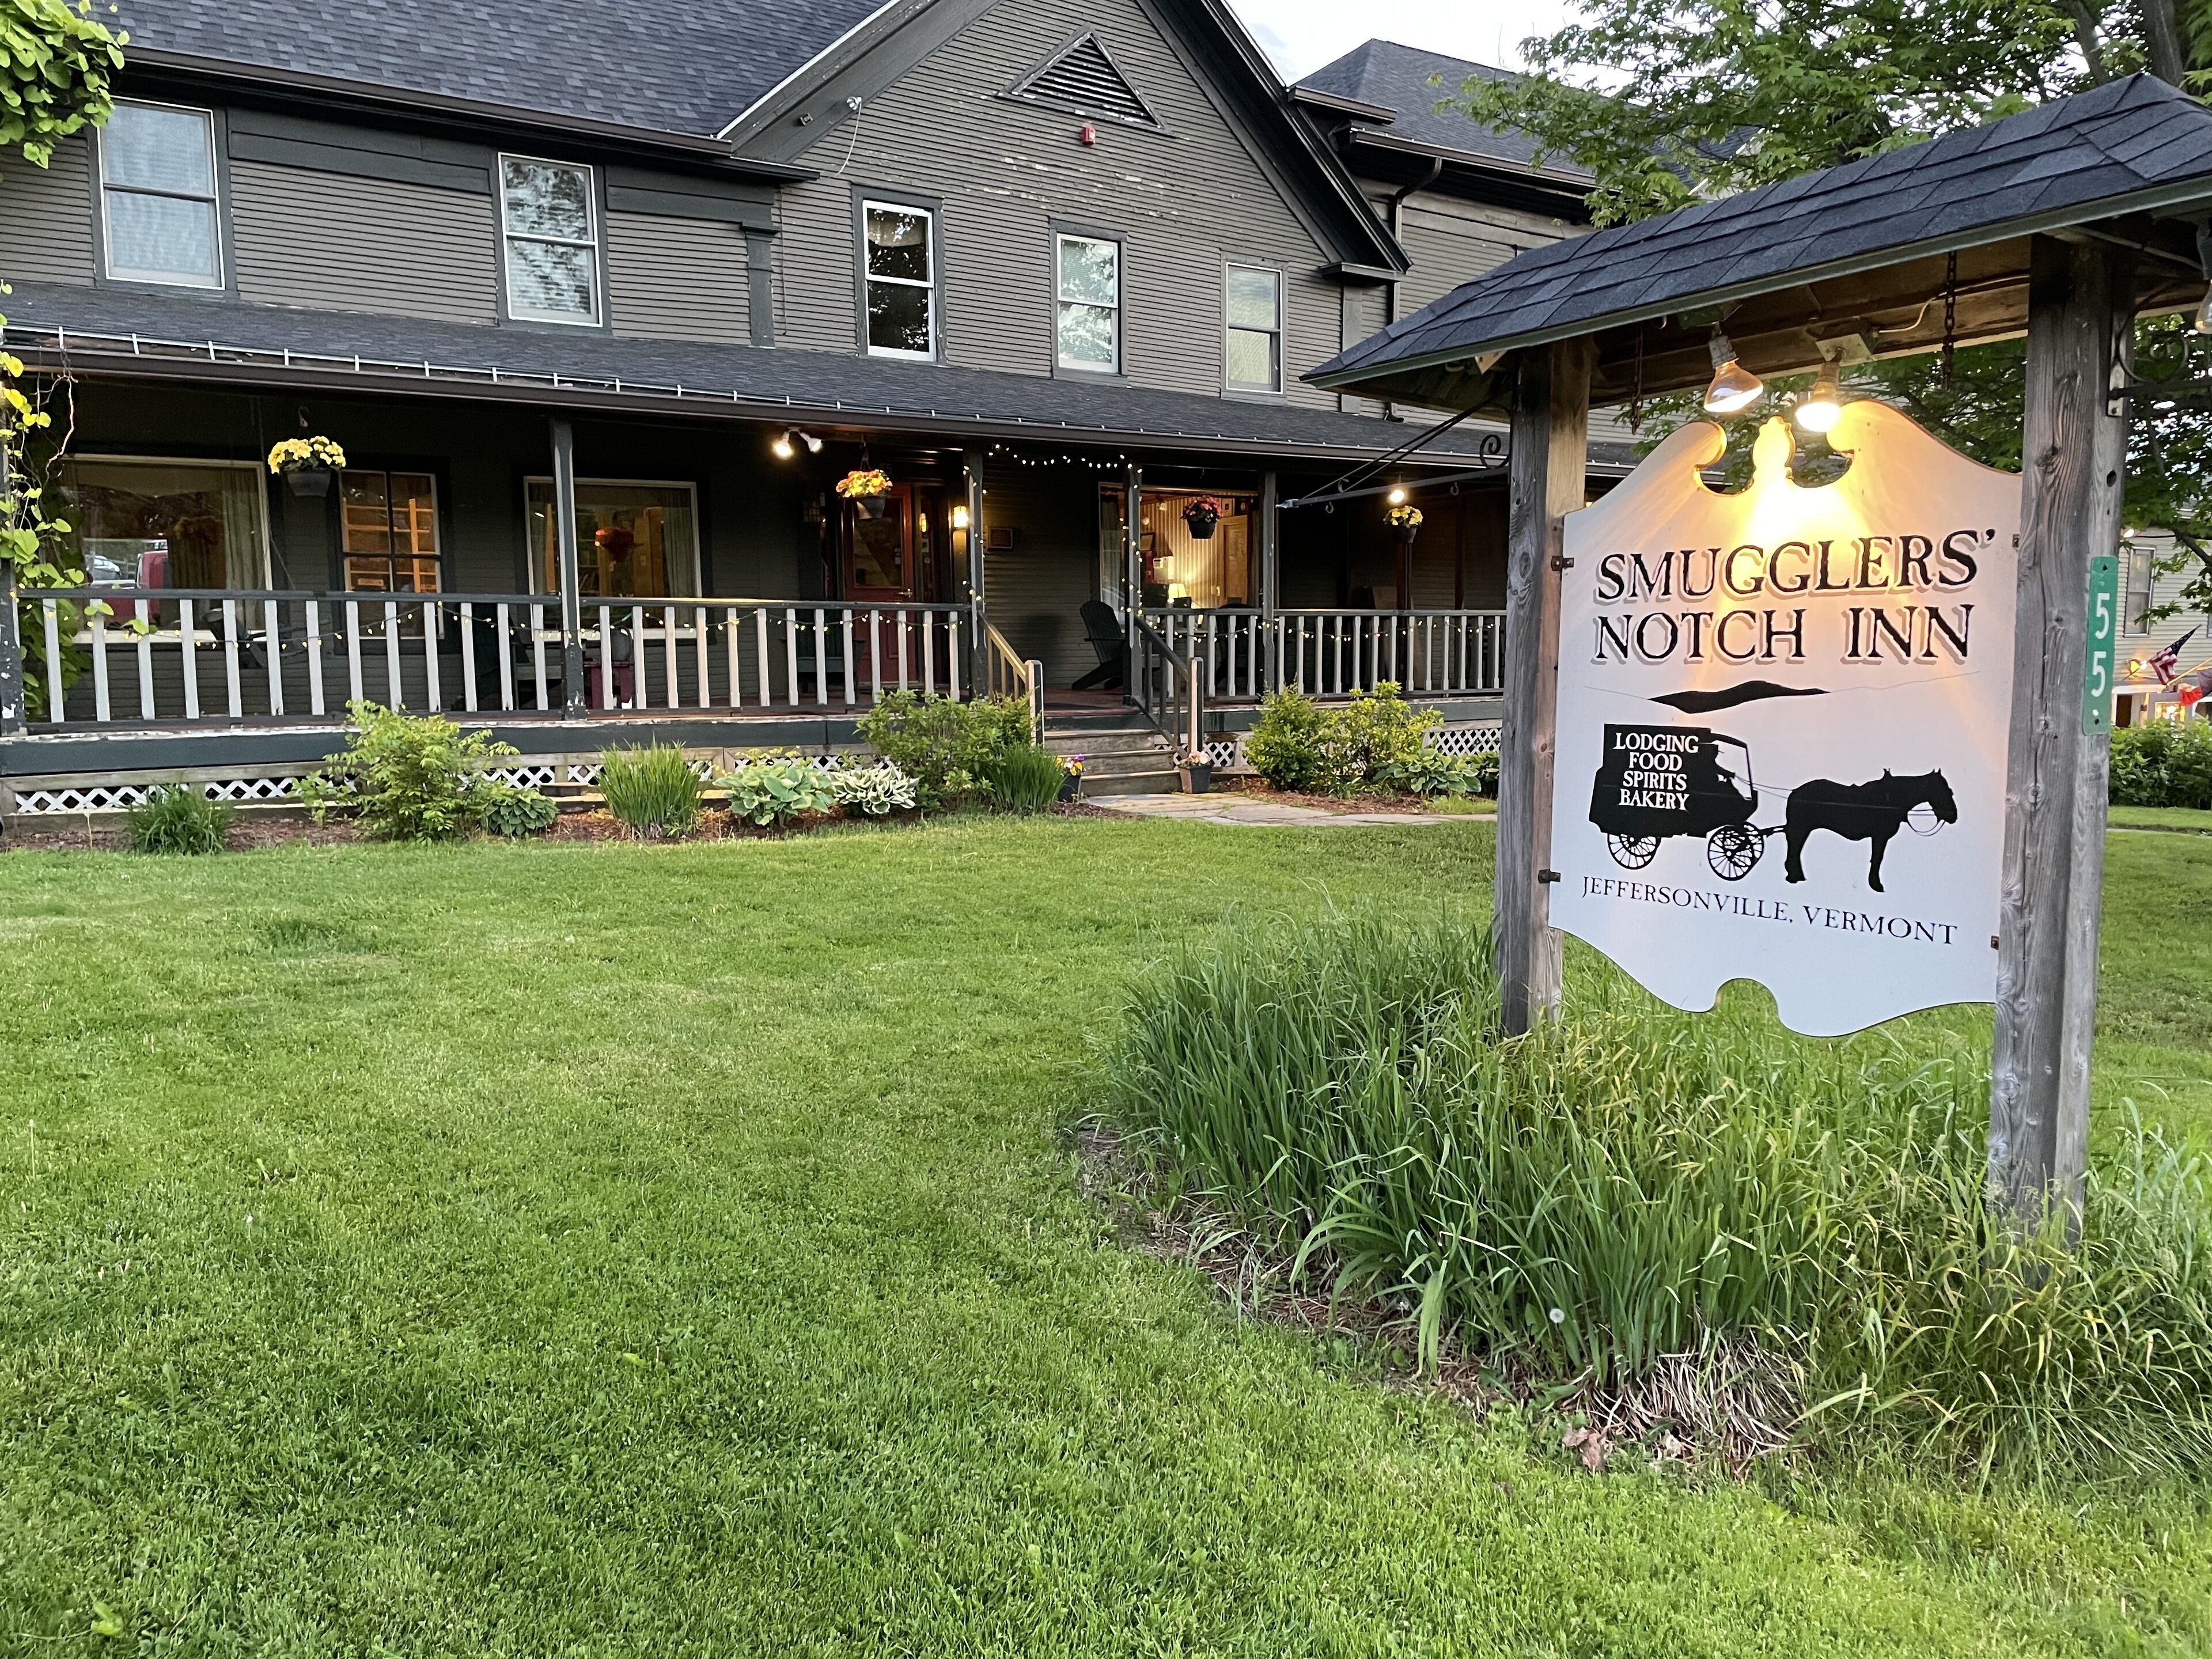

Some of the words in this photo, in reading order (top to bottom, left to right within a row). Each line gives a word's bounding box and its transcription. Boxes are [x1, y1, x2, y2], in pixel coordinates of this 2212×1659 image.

[1596, 529, 1996, 600] SMUGGLERS'
[1596, 608, 1806, 659] NOTCH
[1846, 604, 1975, 658] INN
[2091, 592, 2110, 698] 55
[1612, 732, 1699, 753] LODGING
[1628, 752, 1683, 771] FOOD
[1618, 788, 1690, 811] BAKERY
[1623, 770, 1687, 791] SPIRITS
[1582, 876, 1793, 923] JEFFERSONVILLE,
[1802, 905, 1958, 945] VERMONT
